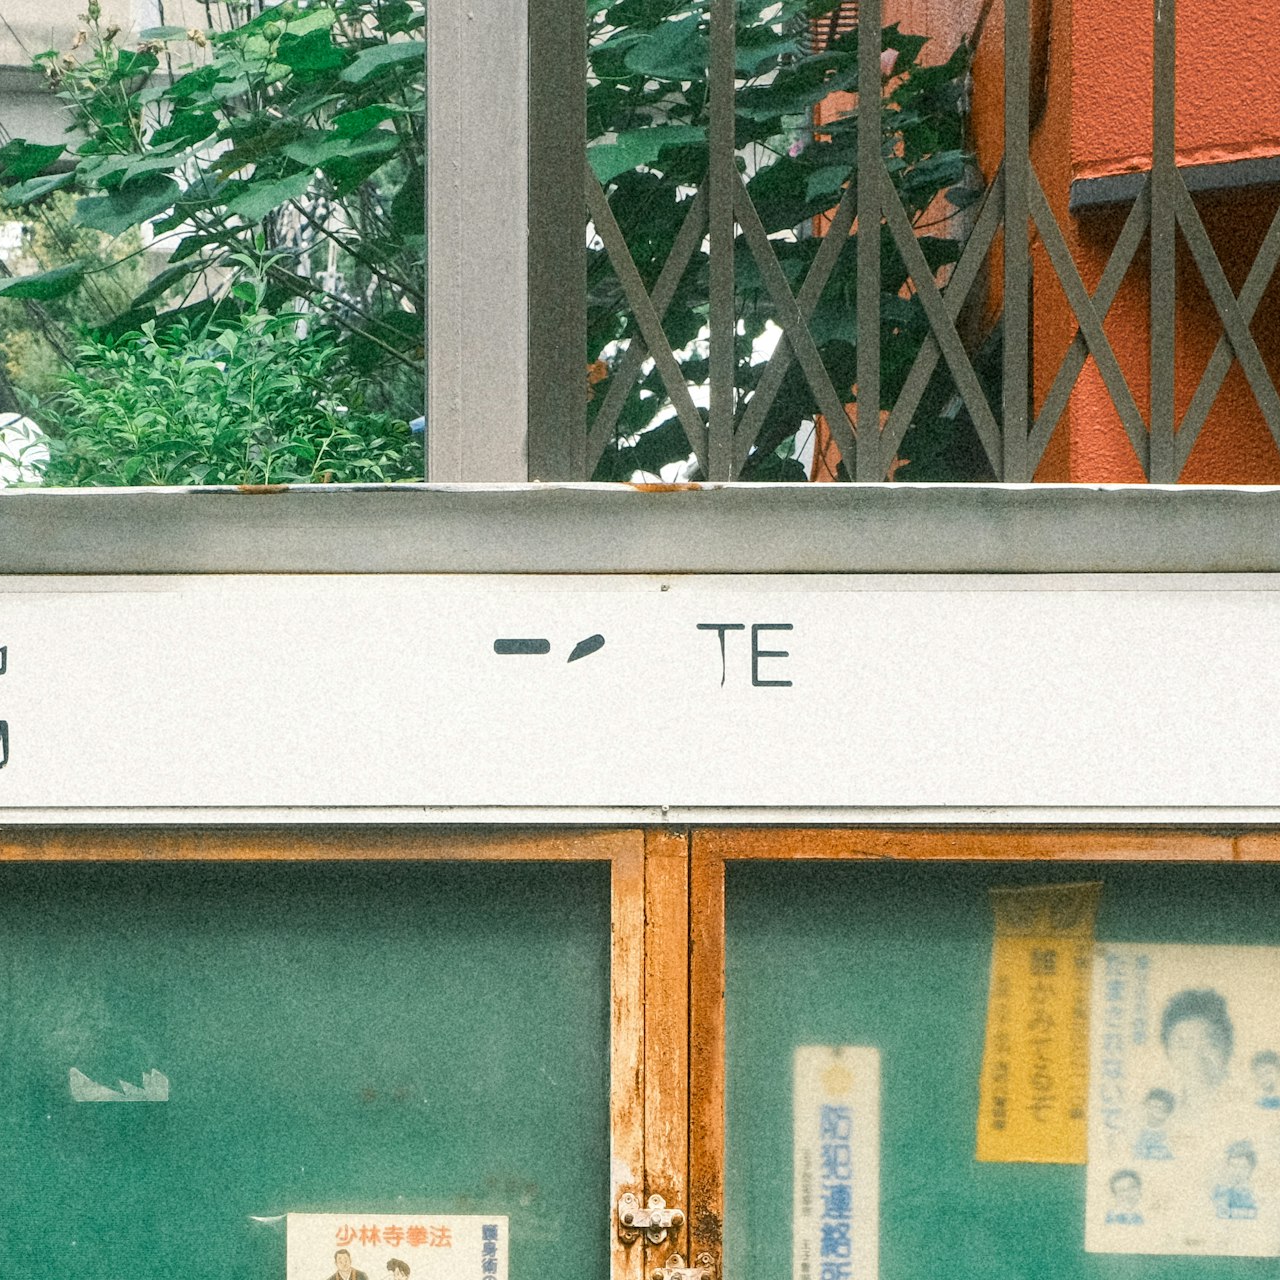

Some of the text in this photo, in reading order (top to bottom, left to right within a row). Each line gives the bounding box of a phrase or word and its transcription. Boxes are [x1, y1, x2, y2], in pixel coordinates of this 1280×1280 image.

[335, 1223, 453, 1248] 少林寺拳法
